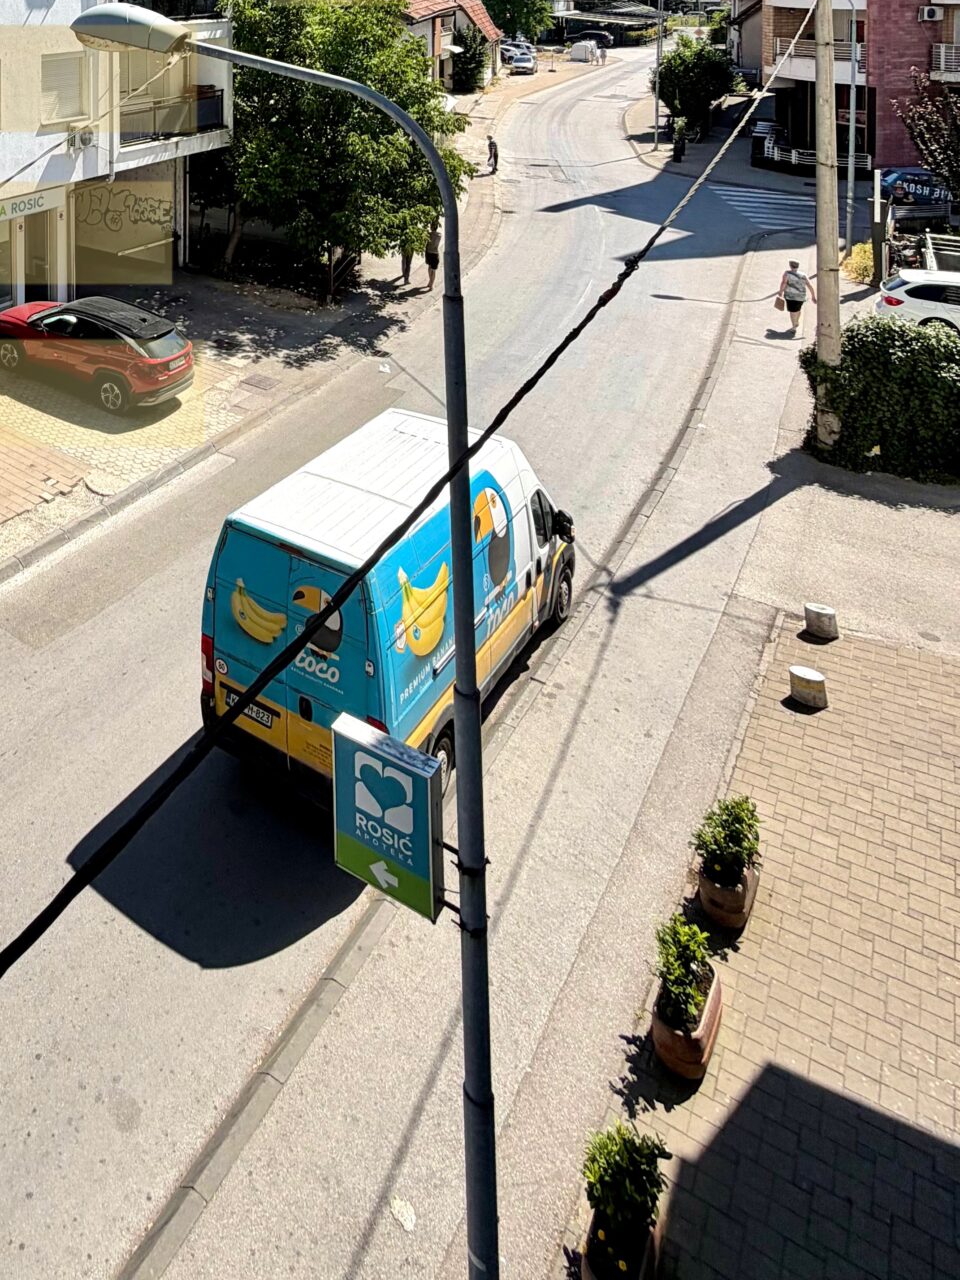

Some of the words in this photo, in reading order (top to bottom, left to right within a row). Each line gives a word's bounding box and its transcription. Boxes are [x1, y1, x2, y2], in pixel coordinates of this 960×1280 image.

[11, 193, 44, 215] ROSIĆ
[400, 662, 431, 705] PREMIUM
[355, 812, 413, 856] ROSIĆ
[355, 828, 414, 867] APOTEKA
